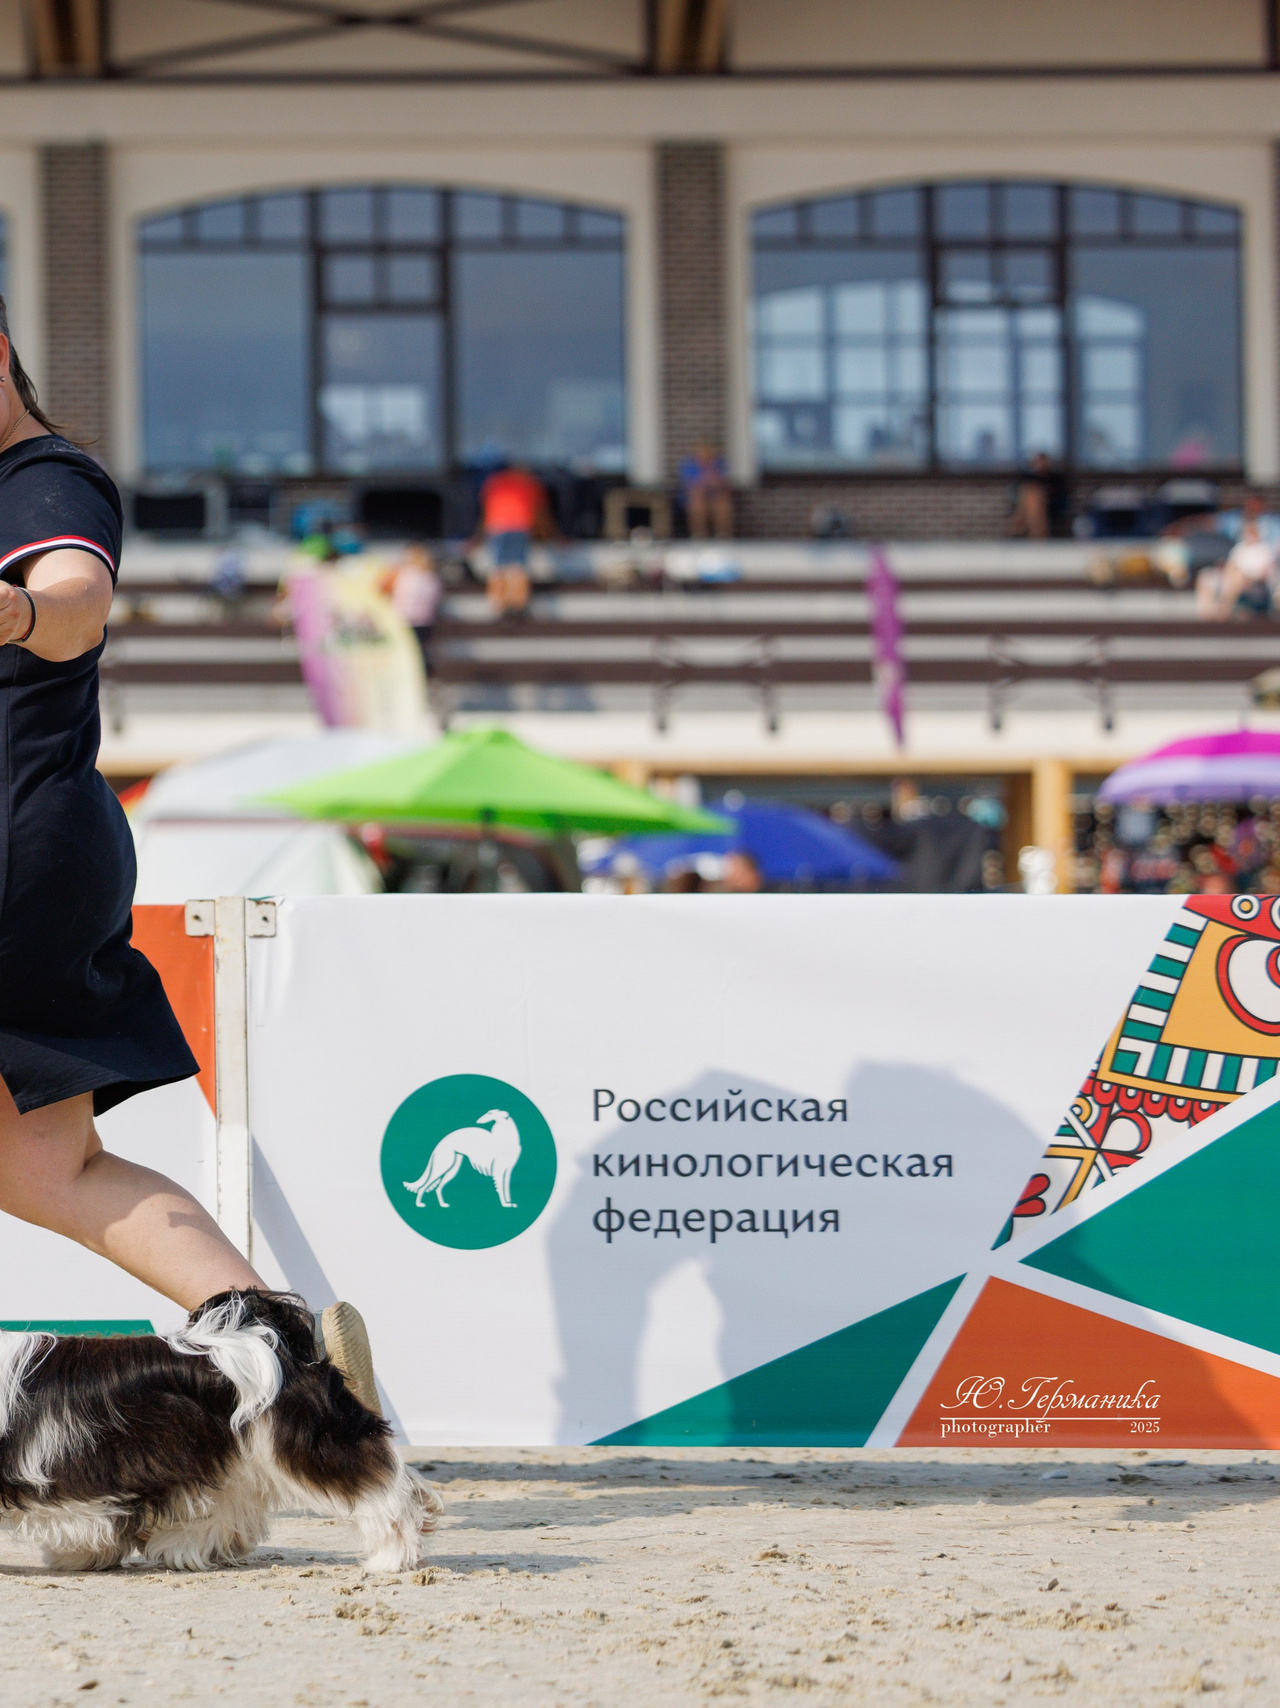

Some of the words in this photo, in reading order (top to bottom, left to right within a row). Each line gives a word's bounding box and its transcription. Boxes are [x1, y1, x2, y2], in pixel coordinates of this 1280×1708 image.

[592, 1088, 848, 1123] Российская
[592, 1153, 954, 1178] кинологическая
[592, 1196, 840, 1244] федерация
